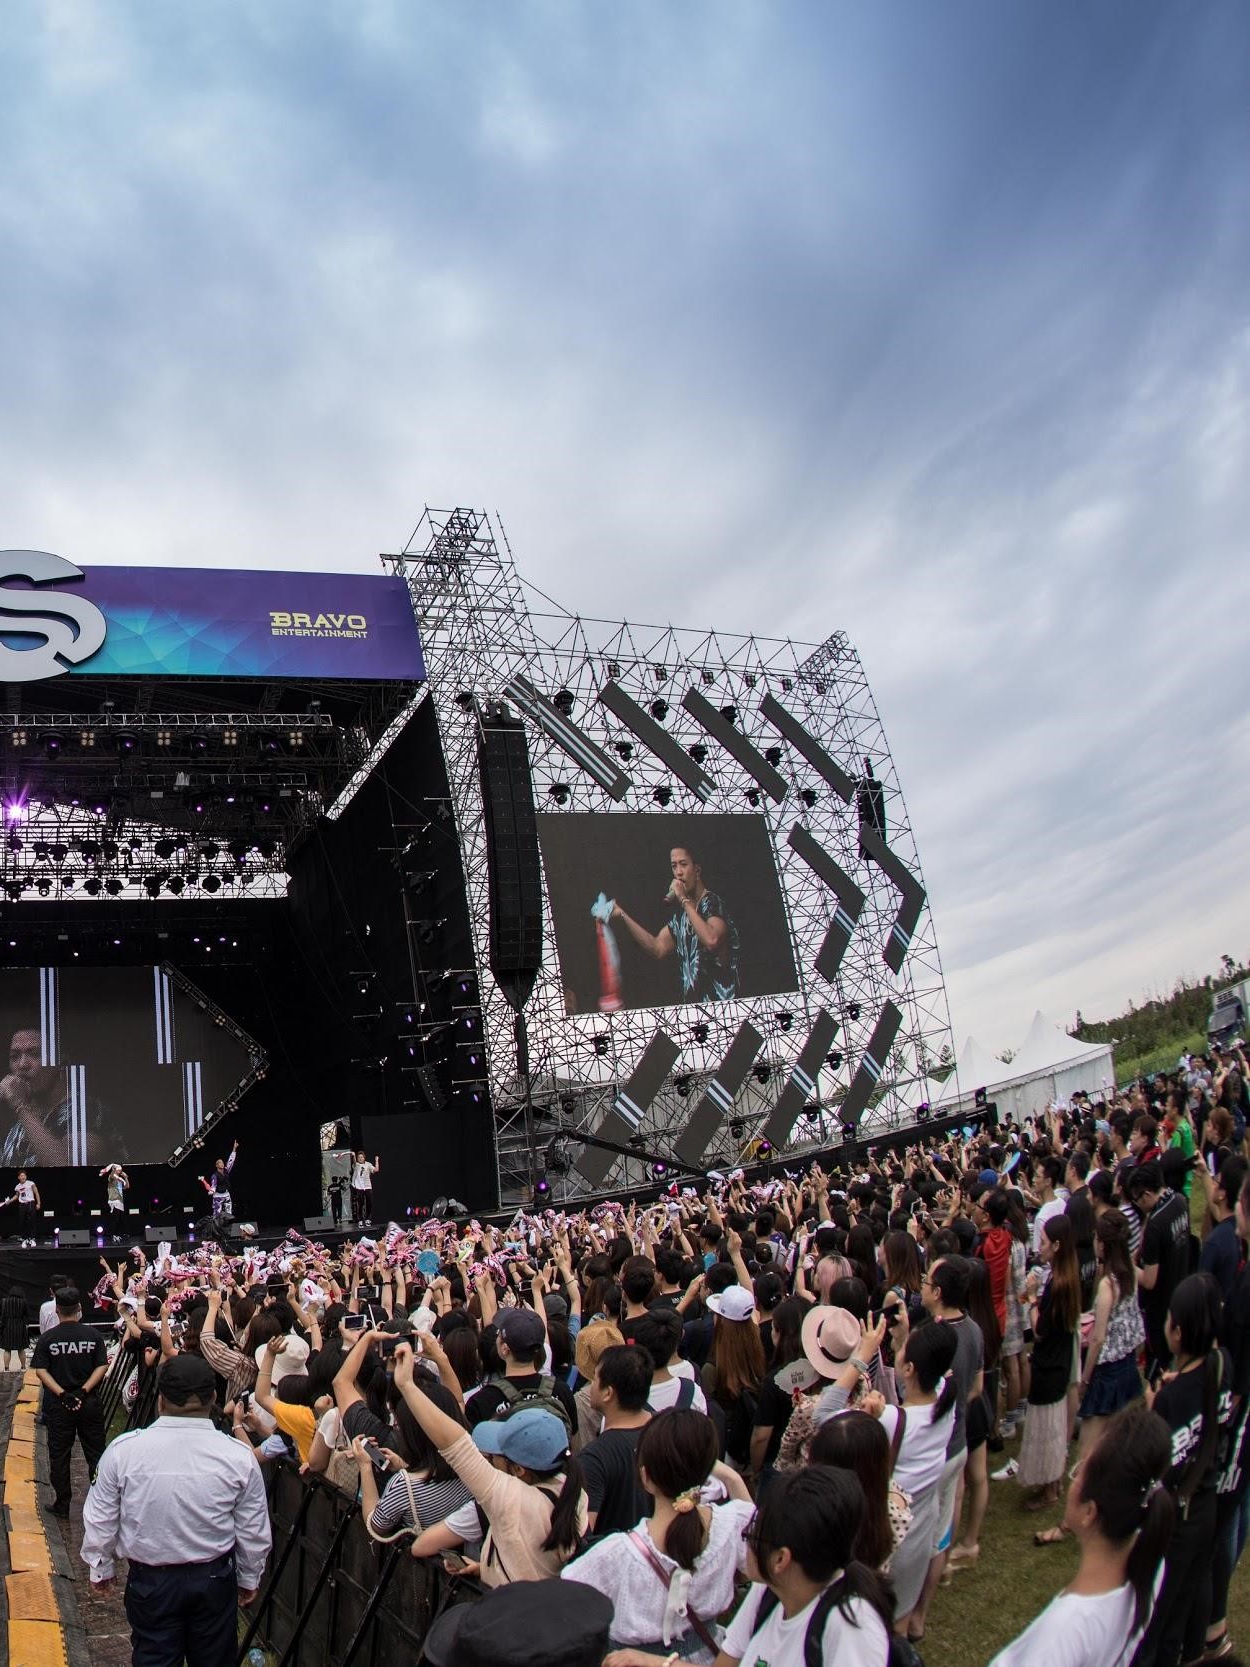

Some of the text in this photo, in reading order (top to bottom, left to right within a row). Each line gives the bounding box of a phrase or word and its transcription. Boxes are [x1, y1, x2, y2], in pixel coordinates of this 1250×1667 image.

[269, 612, 367, 630] BRAVO
[271, 628, 368, 639] ENTERTAINMENT
[49, 1341, 96, 1356] STAFF
